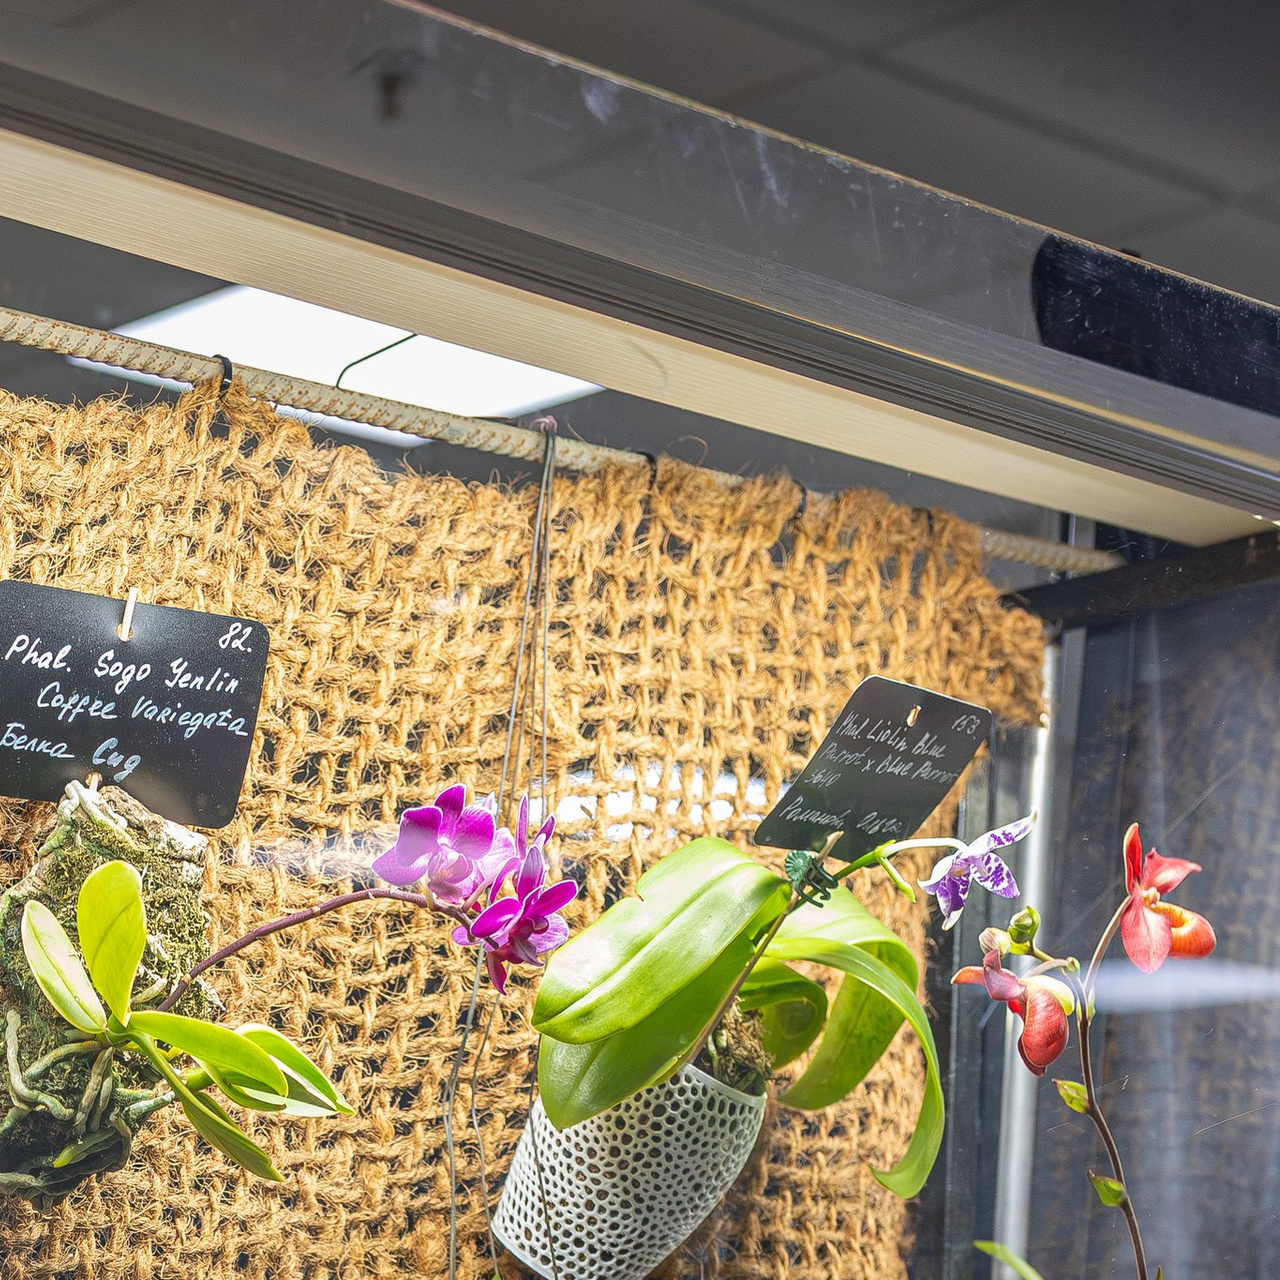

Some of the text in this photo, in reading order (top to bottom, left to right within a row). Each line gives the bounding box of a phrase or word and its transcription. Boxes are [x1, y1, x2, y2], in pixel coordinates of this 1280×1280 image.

[219, 622, 252, 653] 82.
[4, 634, 239, 694] Phal. Sogo Yenlin
[37, 681, 249, 739] Coffee Variegata
[0, 722, 75, 758] Белка
